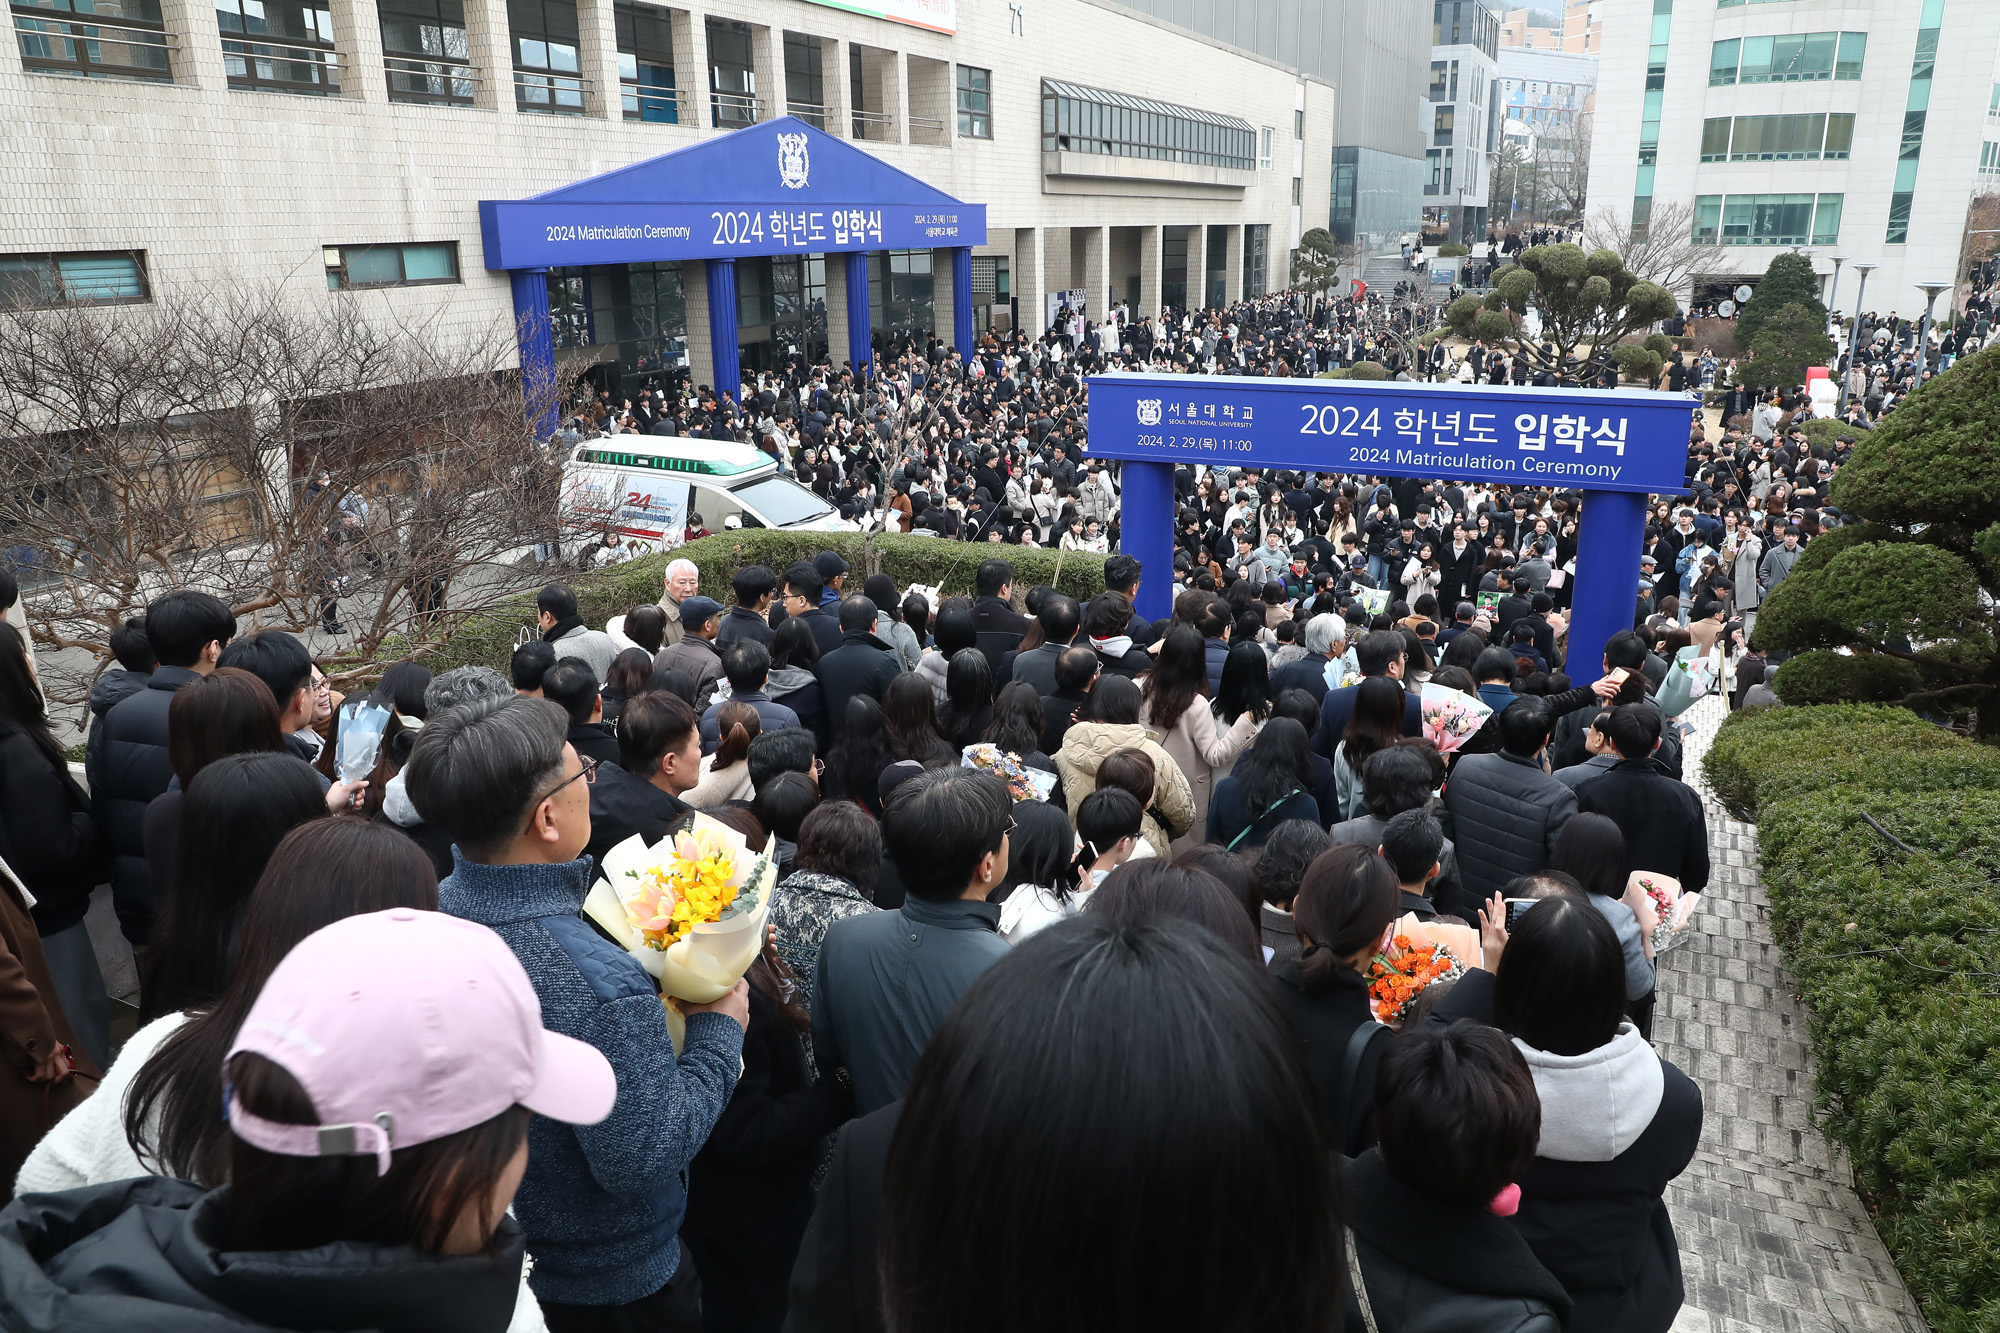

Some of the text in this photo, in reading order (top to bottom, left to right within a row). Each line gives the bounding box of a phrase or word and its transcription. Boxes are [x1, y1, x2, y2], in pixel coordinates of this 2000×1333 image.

[1009, 2, 1023, 37] 71
[546, 224, 691, 242] 2024 Matriculation Ceremony
[711, 209, 882, 247] 2024 학년도 입학식
[1168, 402, 1254, 420] 서울대학교
[1137, 434, 1253, 452] 2024. 2. 29.(목) 11:00
[1300, 404, 1629, 456] 2024 학년도 입학식
[1349, 447, 1622, 481] 2024 Matriculation Ceremony
[624, 492, 651, 510] 24
